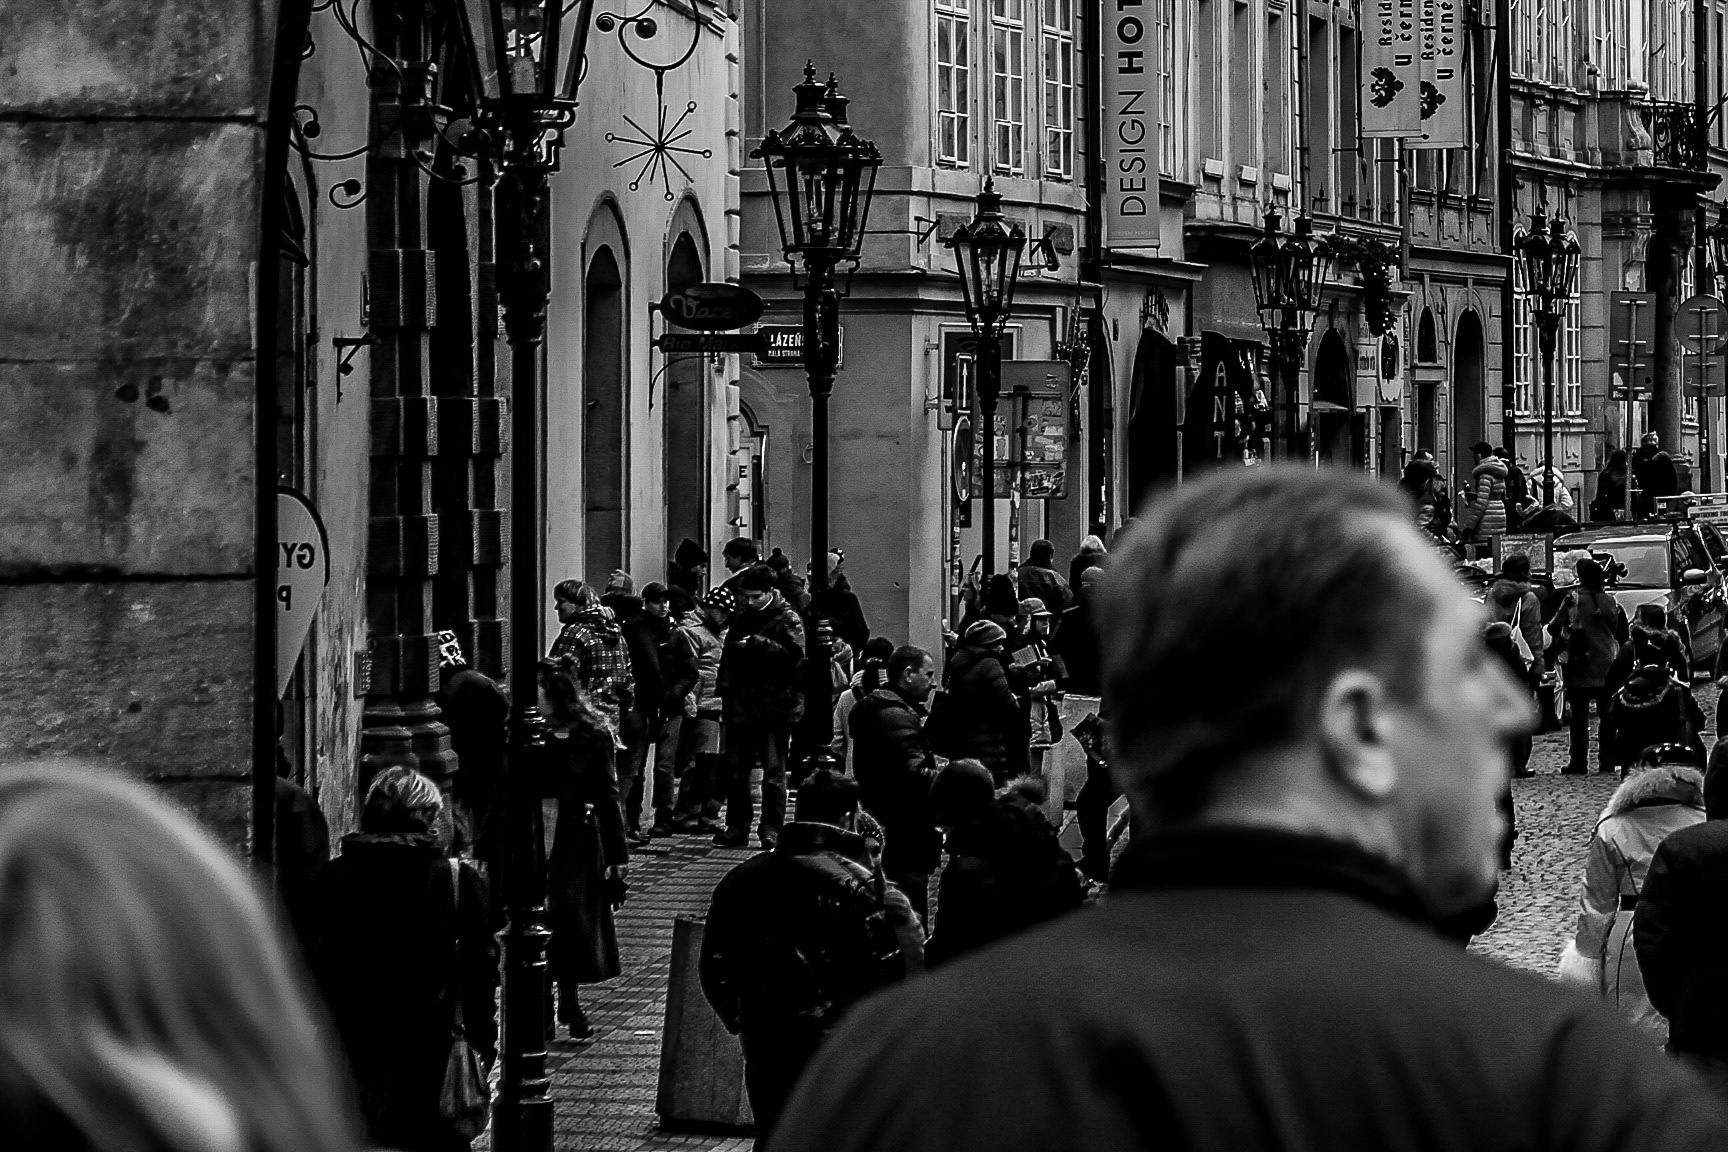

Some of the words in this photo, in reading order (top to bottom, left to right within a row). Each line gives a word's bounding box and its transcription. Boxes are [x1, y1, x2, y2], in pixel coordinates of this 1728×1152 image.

[1394, 54, 1412, 67] U
[1436, 68, 1454, 80] U
[1117, 90, 1147, 217] DESIGN
